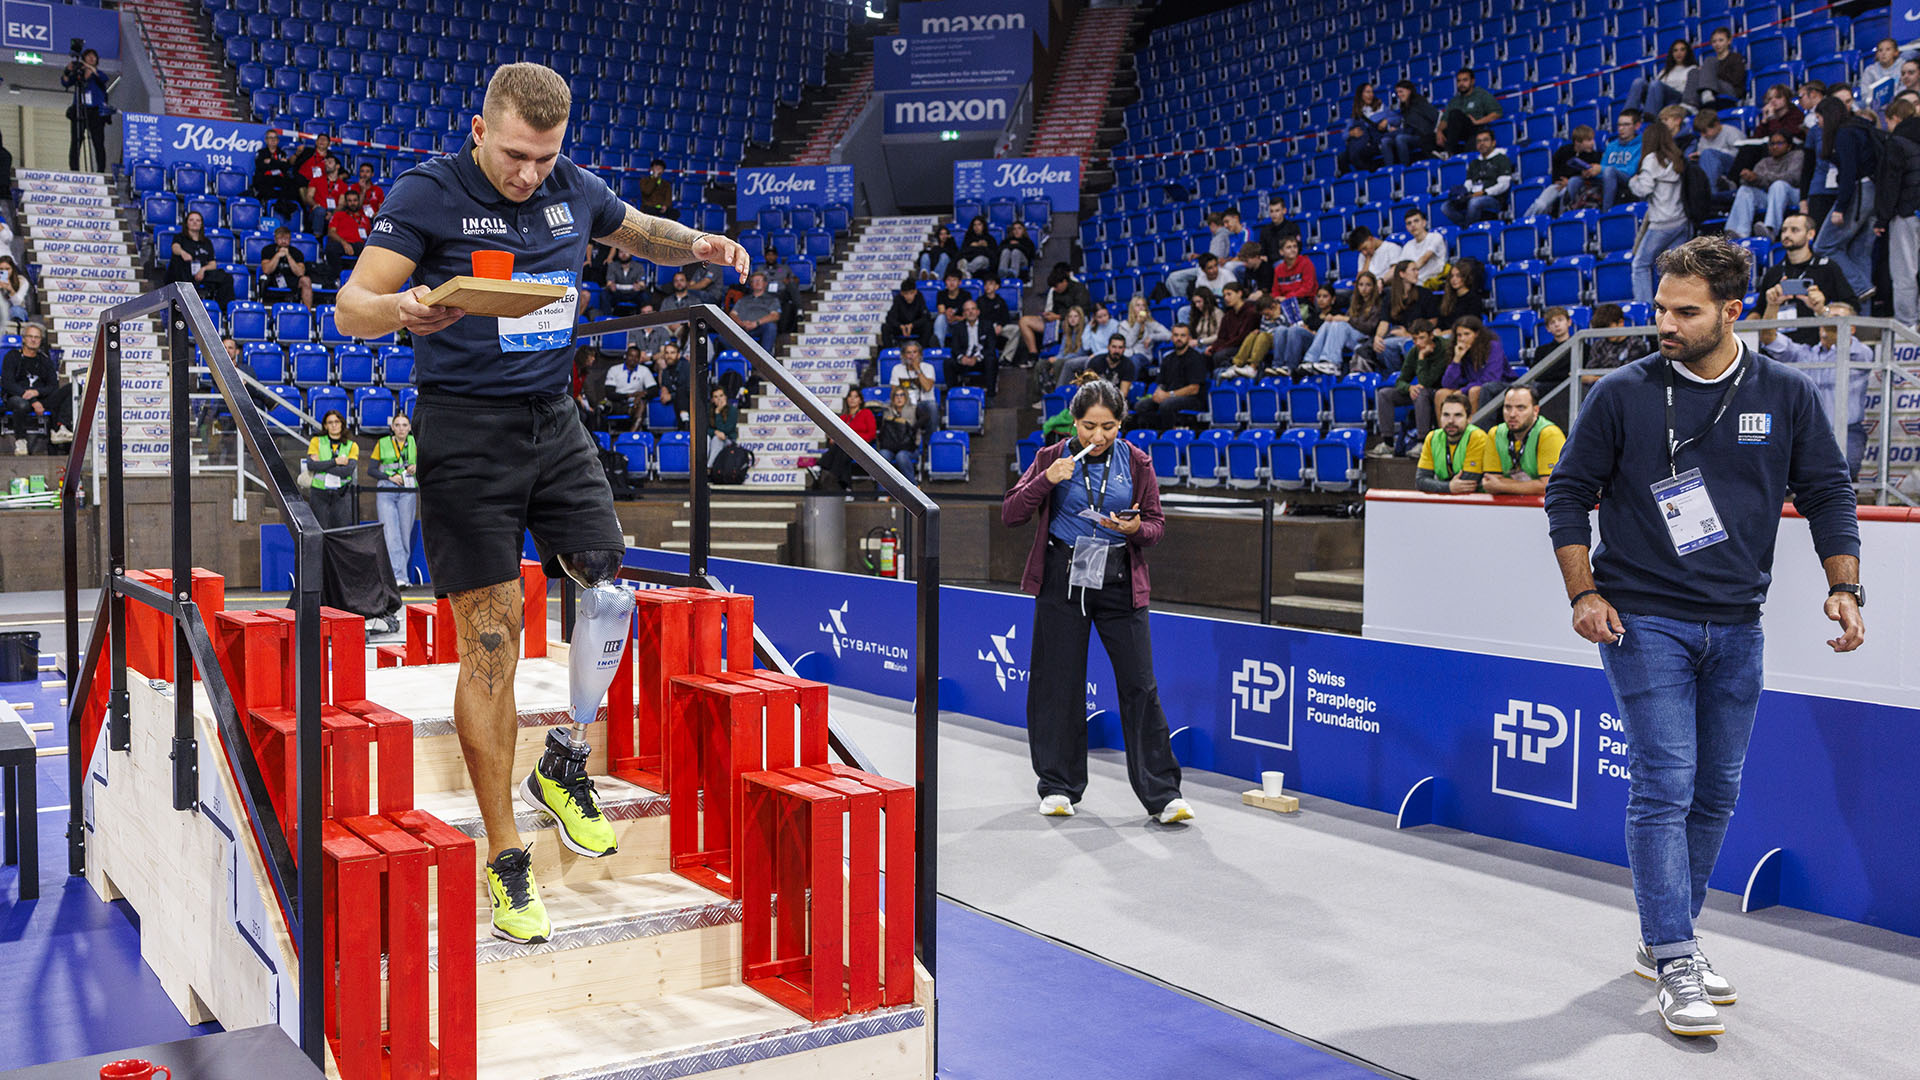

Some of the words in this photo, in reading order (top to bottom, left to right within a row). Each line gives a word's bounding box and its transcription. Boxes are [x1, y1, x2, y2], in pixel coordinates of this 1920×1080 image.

[922, 13, 1025, 34] maxon
[8, 21, 48, 41] EKZ
[895, 98, 1007, 124] maxon
[126, 114, 159, 124] HISTORY
[173, 123, 263, 152] Kloten
[206, 154, 233, 166] 1934
[25, 172, 51, 182] HOPP
[54, 174, 96, 184] CHLOOTE
[993, 163, 1072, 187] Kloten
[744, 173, 816, 195] Kloten
[1021, 188, 1044, 197] 1934
[31, 194, 56, 203] HOPP
[60, 195, 104, 206] CHLOOTE
[769, 196, 790, 205] 1934
[546, 206, 569, 225] iit
[37, 218, 63, 227] HOPP
[66, 219, 111, 230] CHLOOTE
[462, 218, 507, 229] INAIL
[43, 243, 70, 251] HOPP
[74, 244, 119, 254] CHLOOTE
[50, 267, 78, 276] HOPP
[81, 268, 127, 279] CHLOOTE
[57, 294, 85, 303] HOPP
[832, 293, 853, 301] HOPP
[856, 292, 891, 300] CHLOOTE
[819, 314, 841, 322] HOPP
[843, 313, 880, 321] CHLOOTE
[64, 321, 93, 330] HOPP
[538, 321, 551, 329] 511
[830, 336, 868, 344] CHLOOTE
[121, 380, 163, 389] HLOOTE
[756, 414, 781, 422] HOPP
[1741, 416, 1764, 431] iit
[131, 444, 169, 453] CHLOO
[767, 442, 810, 451] CHLOOTE
[752, 473, 797, 482] CHLOOTE
[605, 641, 619, 652] iit
[841, 637, 908, 659] CYBATHLON
[1307, 668, 1346, 688] Swiss
[1306, 688, 1377, 713] Paraplegic
[1306, 707, 1380, 734] Foundation
